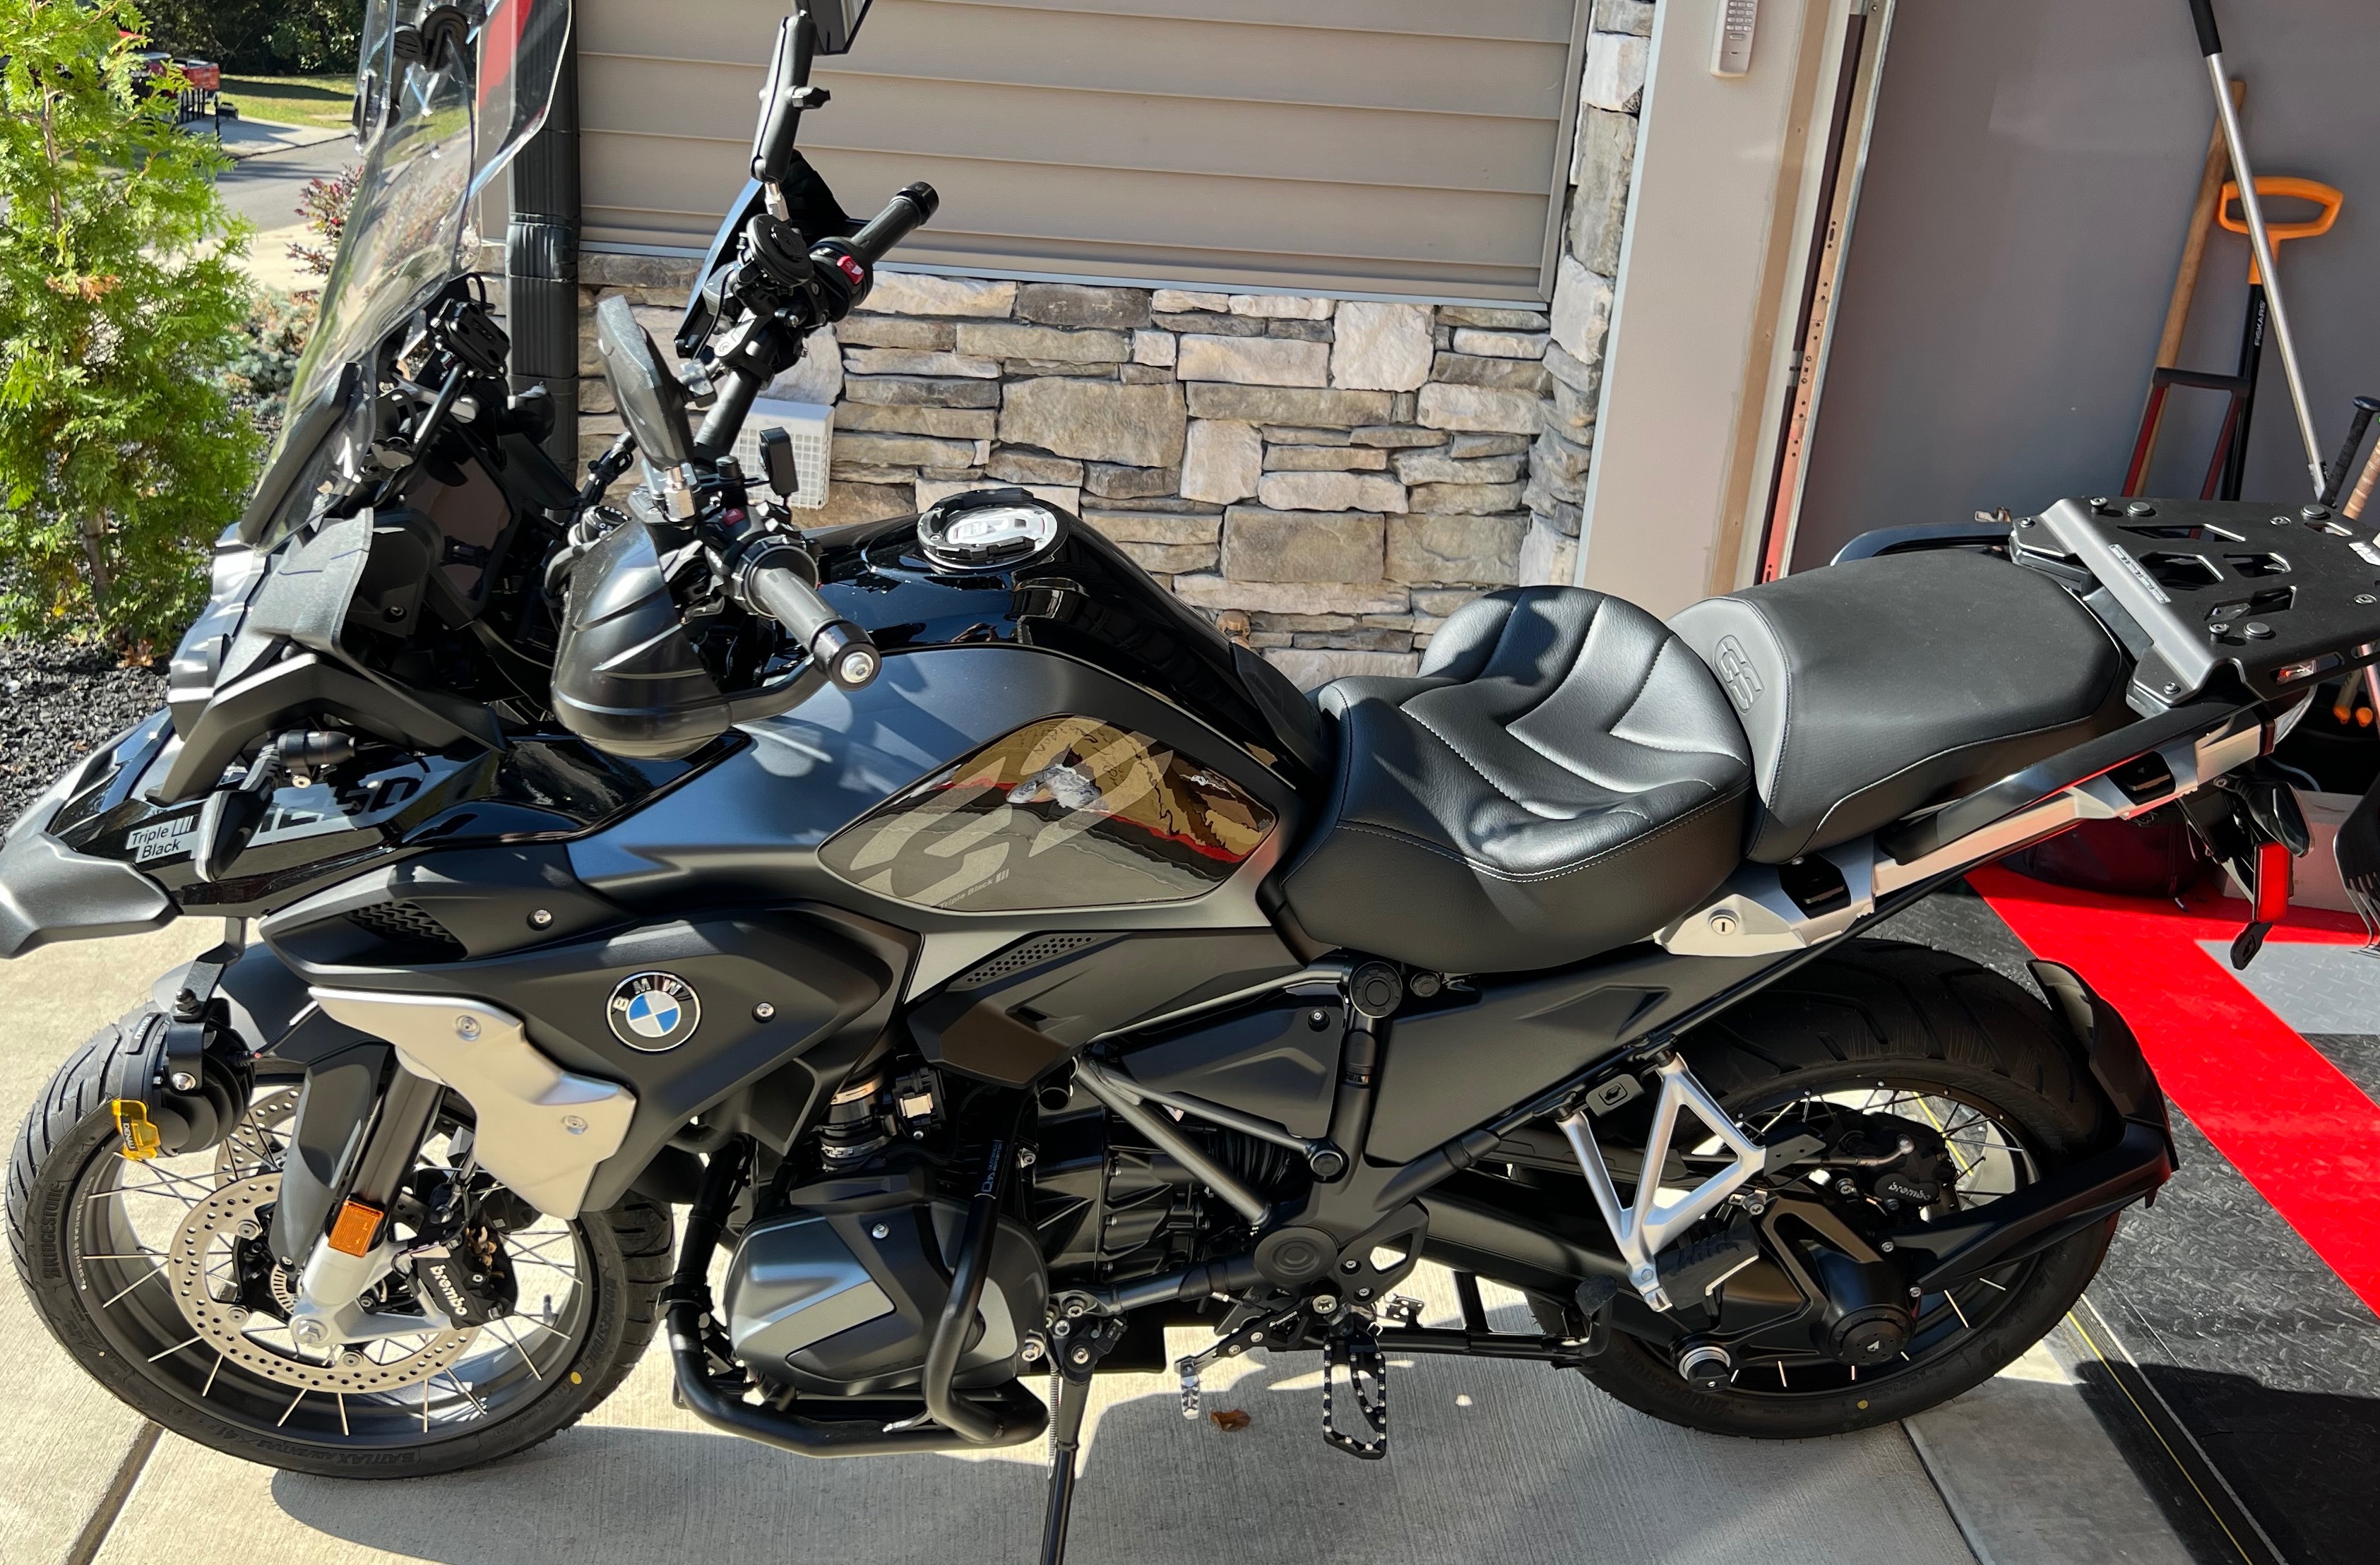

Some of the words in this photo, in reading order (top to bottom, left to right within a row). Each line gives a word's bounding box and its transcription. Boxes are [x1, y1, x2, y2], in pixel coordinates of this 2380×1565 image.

[132, 826, 169, 845] Triple
[142, 839, 181, 859] Black
[939, 893, 966, 909] Triple
[968, 879, 994, 896] Black
[612, 978, 682, 1011] BMW
[1888, 1182, 1932, 1201] brembo
[40, 1183, 65, 1279] BRIDGESTONE
[429, 1265, 468, 1315] brembo
